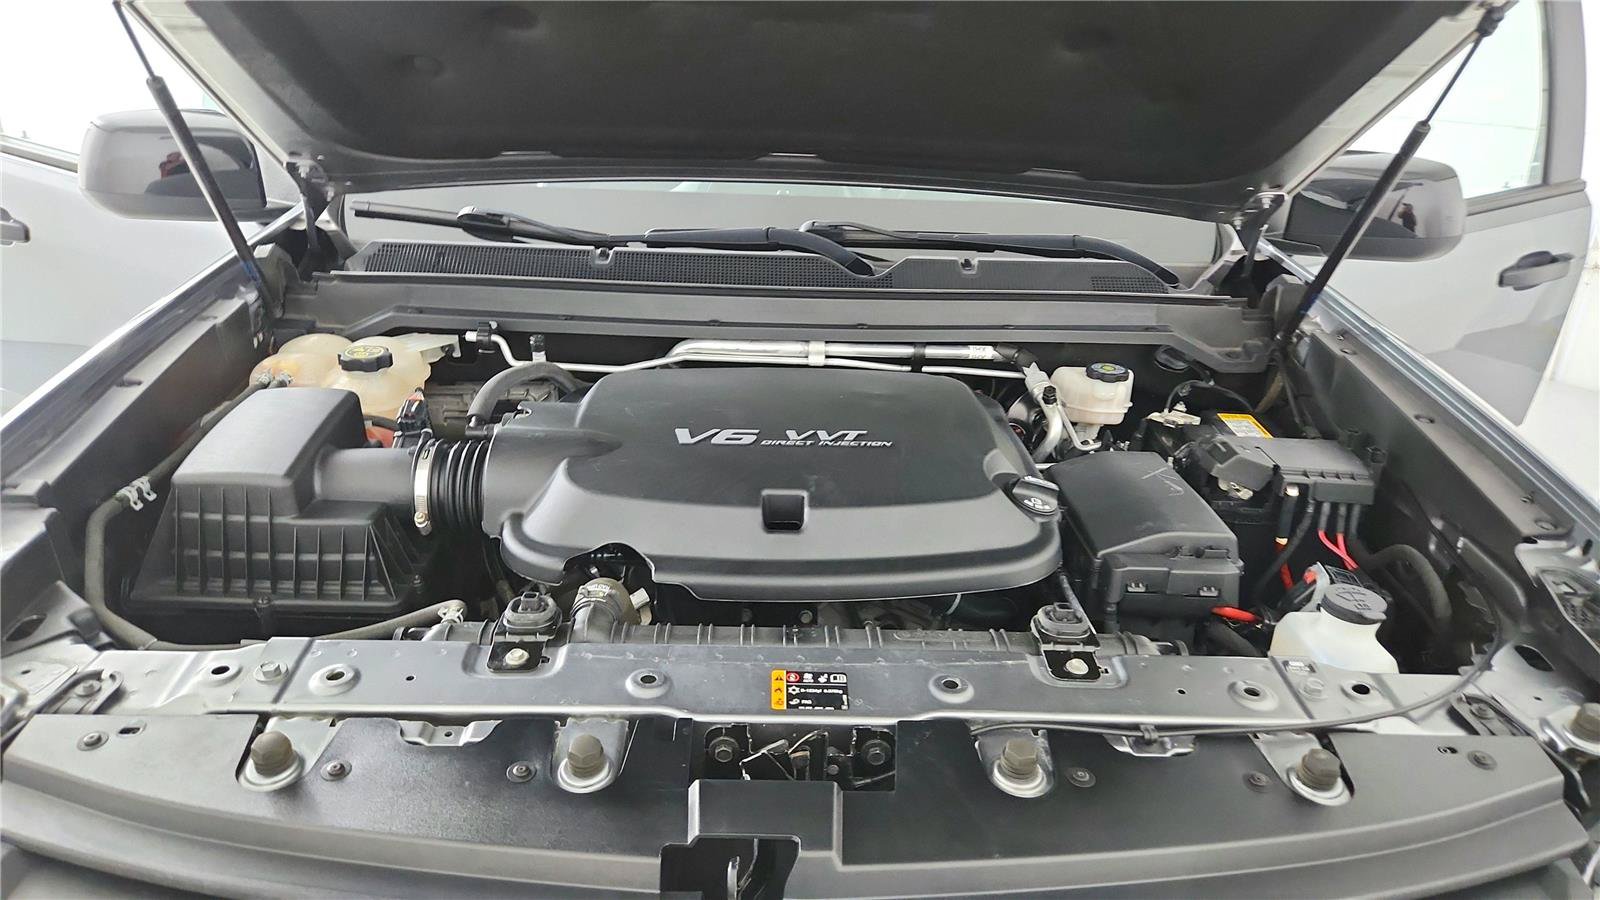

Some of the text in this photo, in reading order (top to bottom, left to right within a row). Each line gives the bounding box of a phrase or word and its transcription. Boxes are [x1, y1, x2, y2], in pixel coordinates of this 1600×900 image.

[675, 428, 760, 445] V6
[785, 429, 868, 441] VVT
[818, 440, 893, 448] INJECTION
